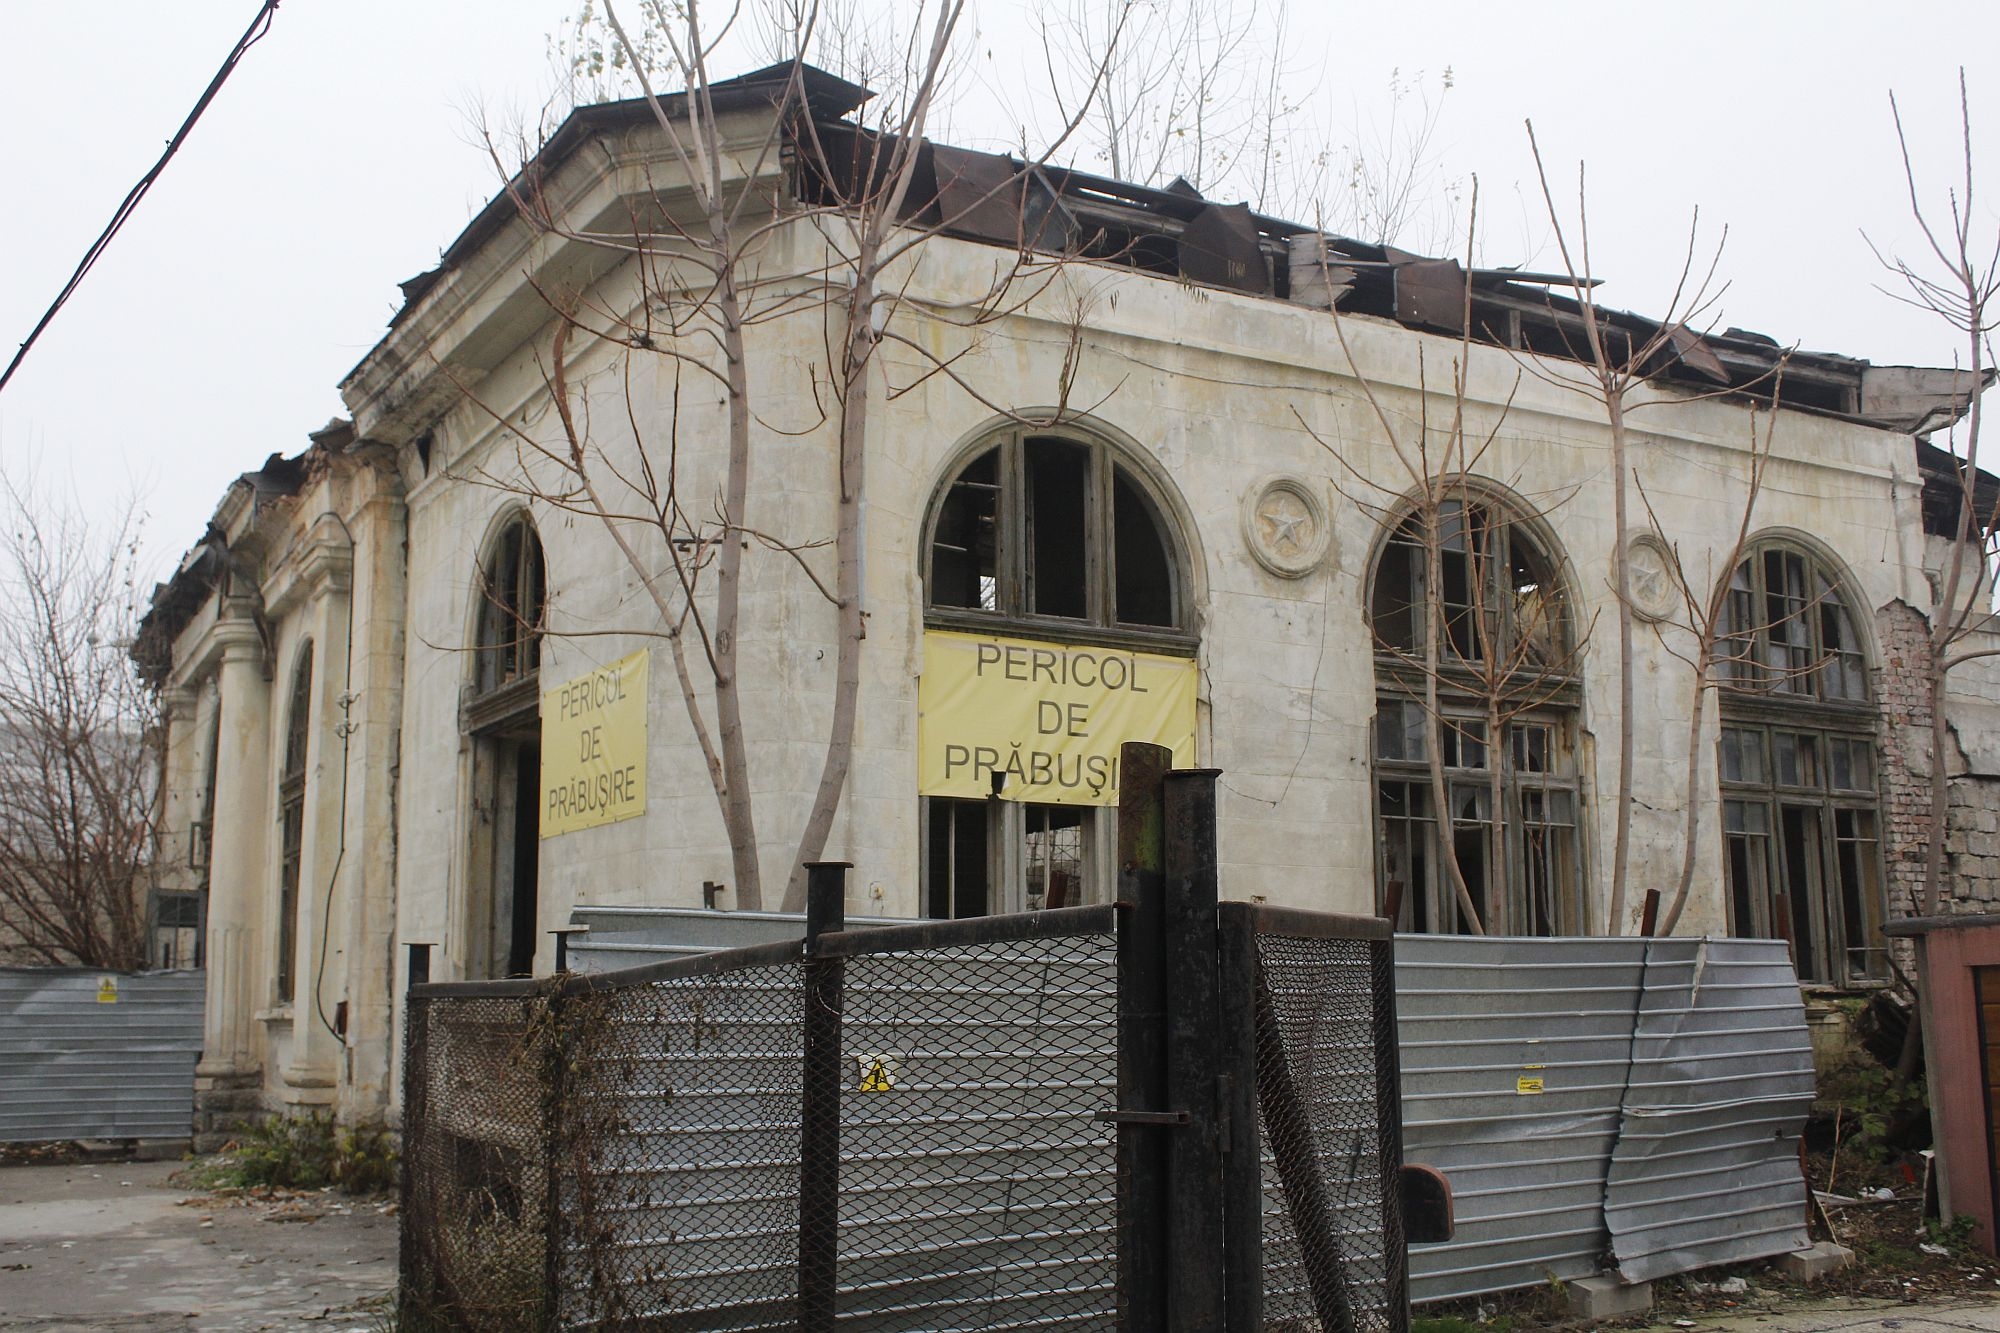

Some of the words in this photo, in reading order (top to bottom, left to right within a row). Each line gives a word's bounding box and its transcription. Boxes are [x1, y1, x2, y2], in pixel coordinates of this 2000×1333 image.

[977, 643, 1148, 692] PERICOL
[561, 667, 626, 721] PERICOL
[1038, 700, 1089, 737] DE
[580, 726, 602, 763] DE
